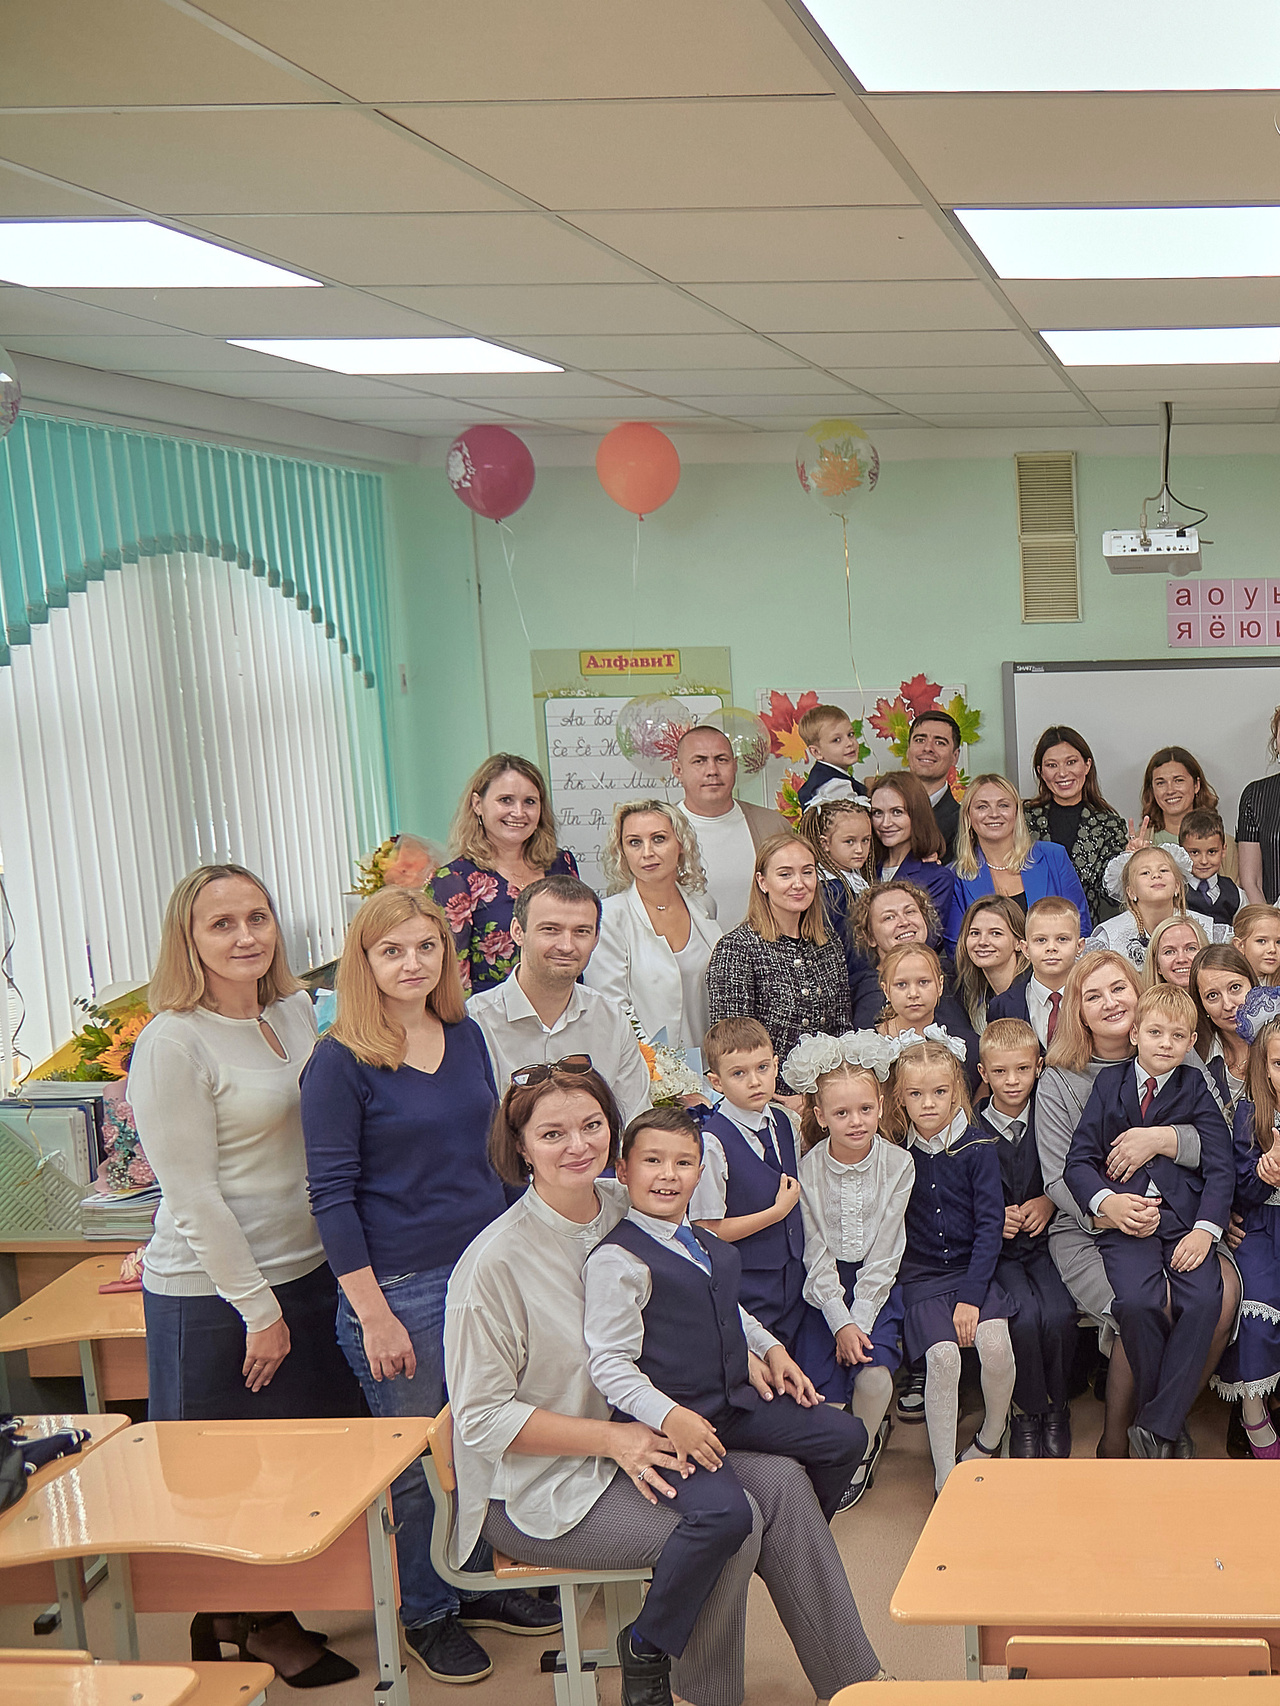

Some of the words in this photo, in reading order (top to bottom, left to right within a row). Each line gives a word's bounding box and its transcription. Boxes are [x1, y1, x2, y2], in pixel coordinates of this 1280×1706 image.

[1175, 587, 1192, 606] а
[1207, 587, 1225, 606] о
[1243, 587, 1259, 610] у
[1176, 621, 1192, 640] я
[1209, 615, 1226, 639] ё
[1240, 620, 1261, 639] ю
[560, 708, 586, 727] Аа
[563, 772, 587, 790] Кк
[623, 770, 658, 789] Мм
